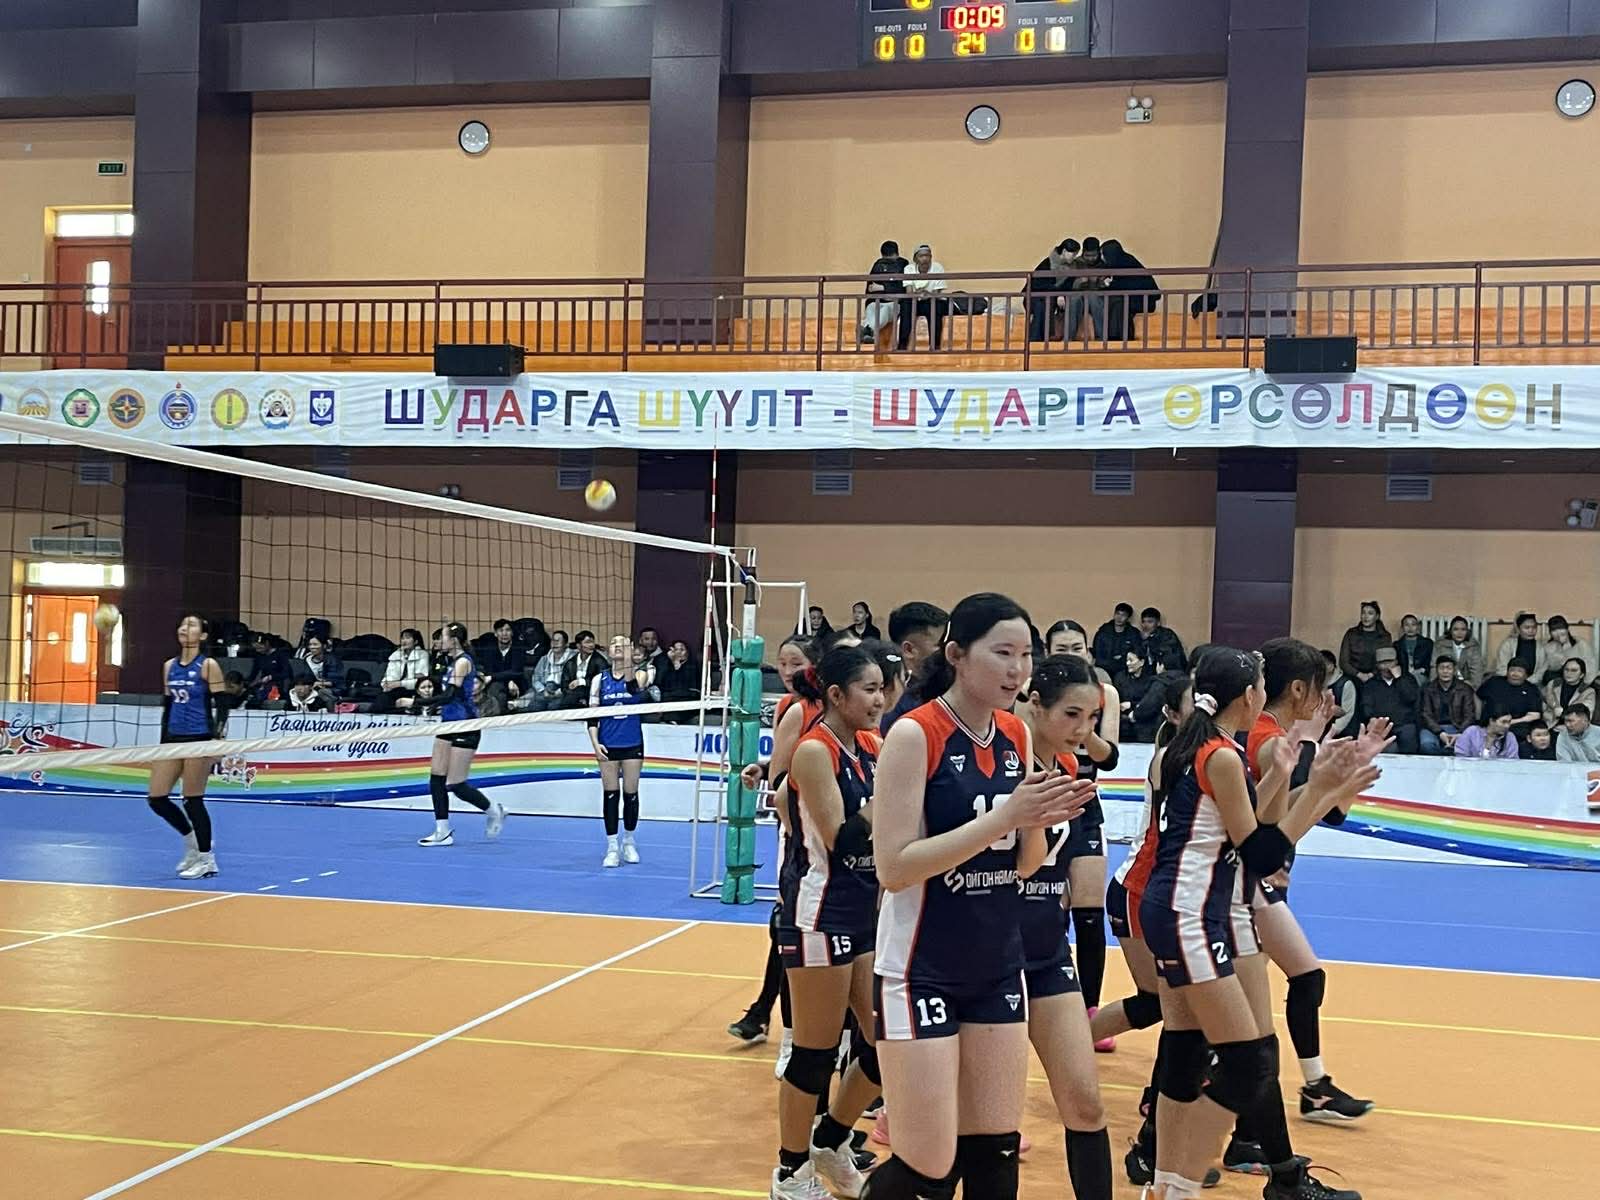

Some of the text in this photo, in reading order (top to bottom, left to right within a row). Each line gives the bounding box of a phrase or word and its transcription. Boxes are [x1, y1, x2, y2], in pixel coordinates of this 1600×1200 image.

[907, 22, 927, 31] FOULS
[954, 5, 1005, 29] 0:09
[1017, 17, 1039, 26] FOULS
[879, 35, 895, 58] 0
[909, 33, 925, 57] 0
[957, 31, 986, 55] 24
[1019, 27, 1035, 52] 0
[384, 388, 621, 434] ШУДАРГА
[638, 388, 814, 428] ШҮҮЛТ
[872, 386, 1141, 435] ШУДАРГА
[1163, 382, 1562, 433] ӨРСӨЛДӨӨН
[831, 935, 852, 956] 15
[1211, 941, 1228, 964] 2
[916, 997, 948, 1027] 13
